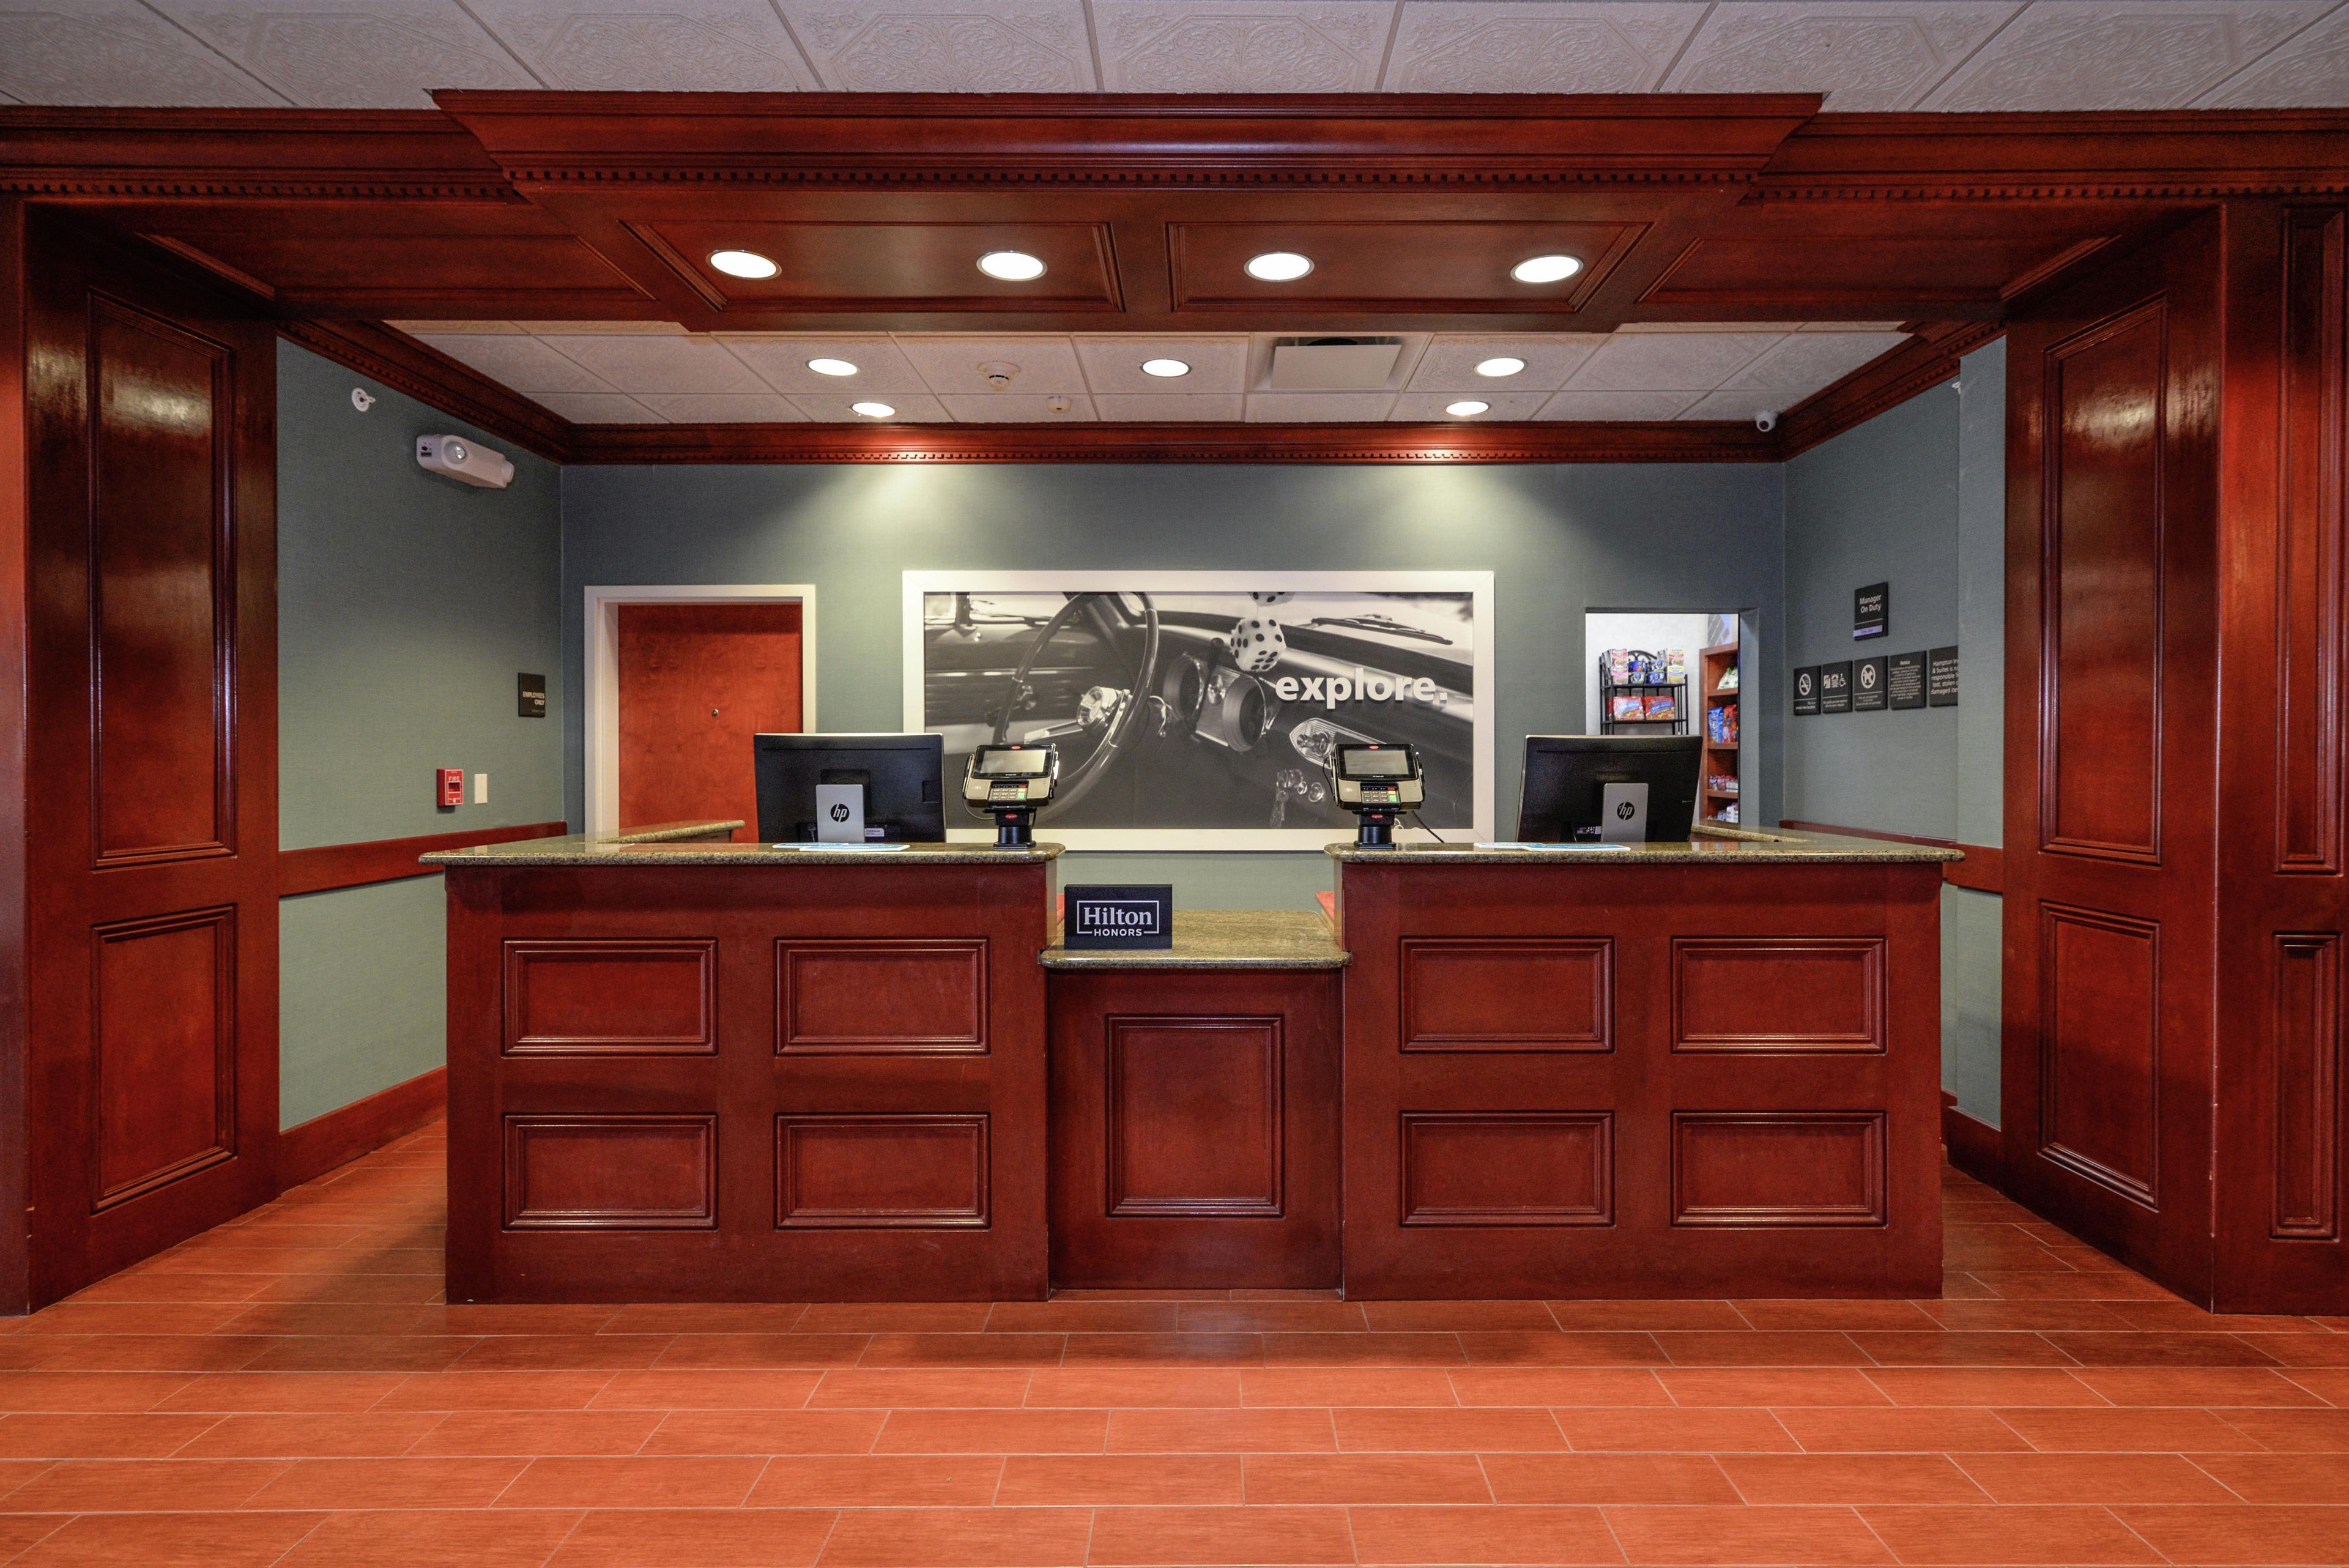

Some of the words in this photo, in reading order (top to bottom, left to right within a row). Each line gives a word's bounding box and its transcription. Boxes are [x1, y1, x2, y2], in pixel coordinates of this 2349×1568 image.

[1860, 595, 1882, 604] Manager
[1931, 672, 1954, 681] responsible
[1275, 667, 1448, 709] explore.
[831, 803, 849, 822] hp
[1617, 802, 1635, 820] hp
[1083, 907, 1152, 925] Hilton
